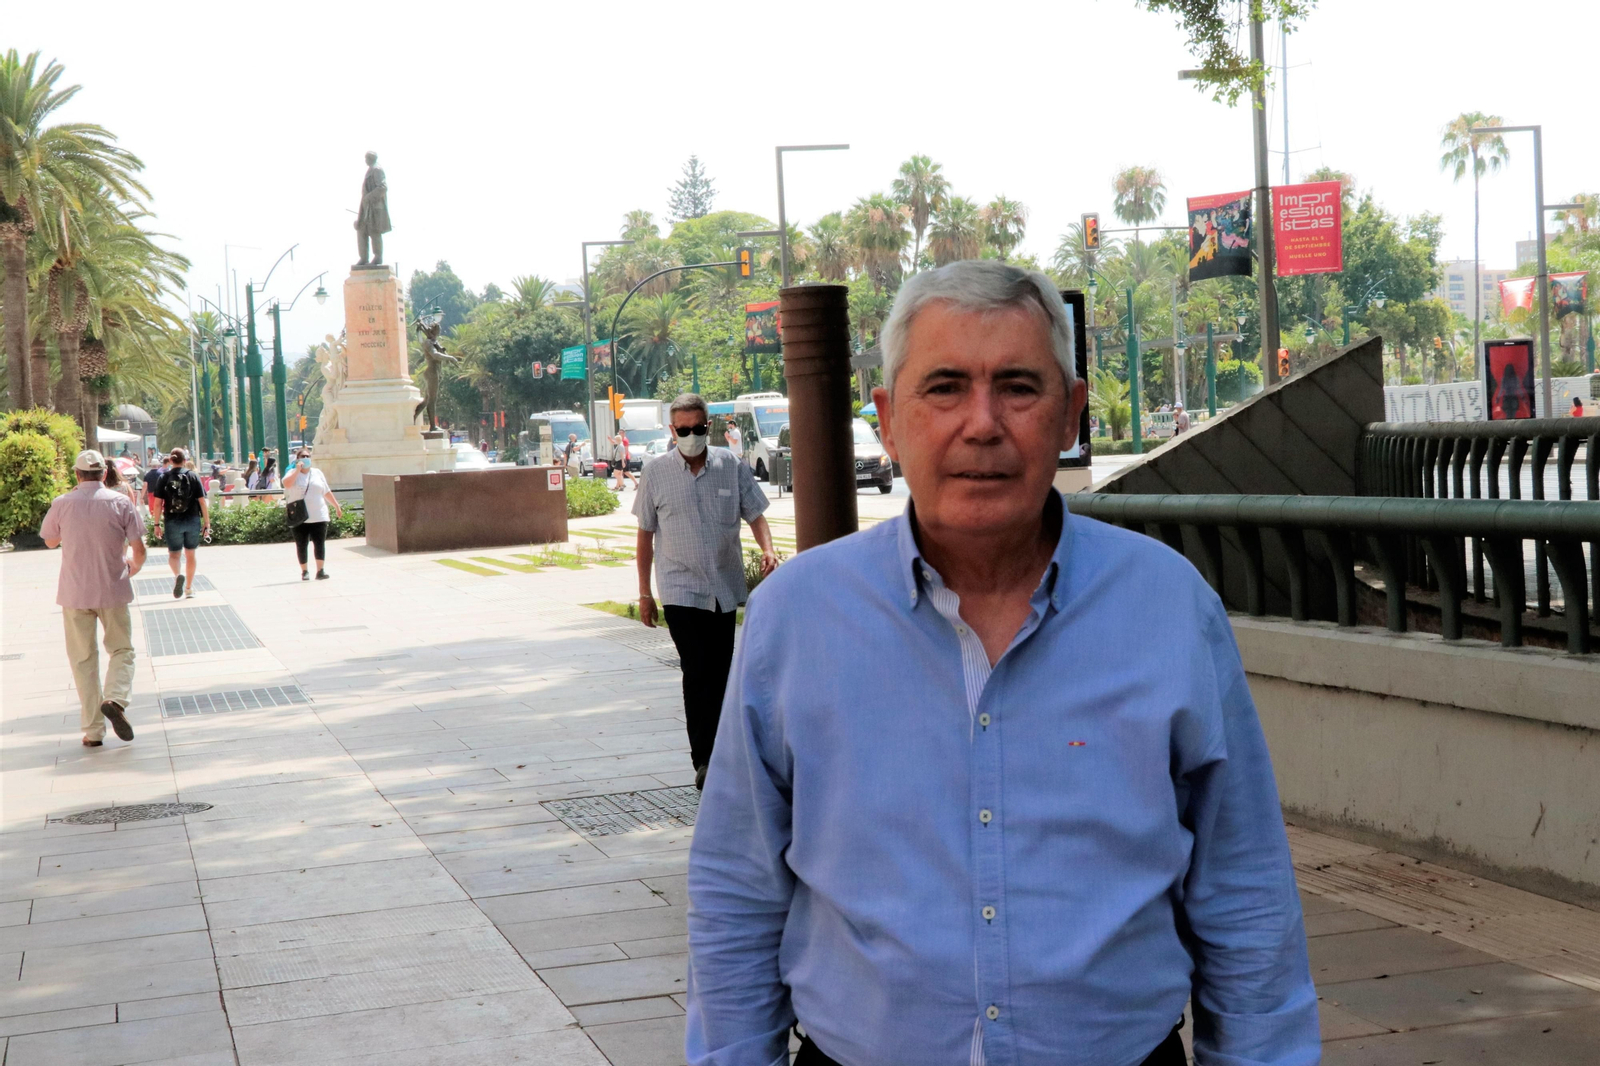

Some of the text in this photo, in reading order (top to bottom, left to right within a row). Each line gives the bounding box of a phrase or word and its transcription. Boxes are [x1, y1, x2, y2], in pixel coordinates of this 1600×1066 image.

[1280, 192, 1332, 207] Impr
[1280, 203, 1333, 218] esion
[1280, 217, 1334, 231] istas
[1293, 242, 1331, 250] SEPTIEMBRE
